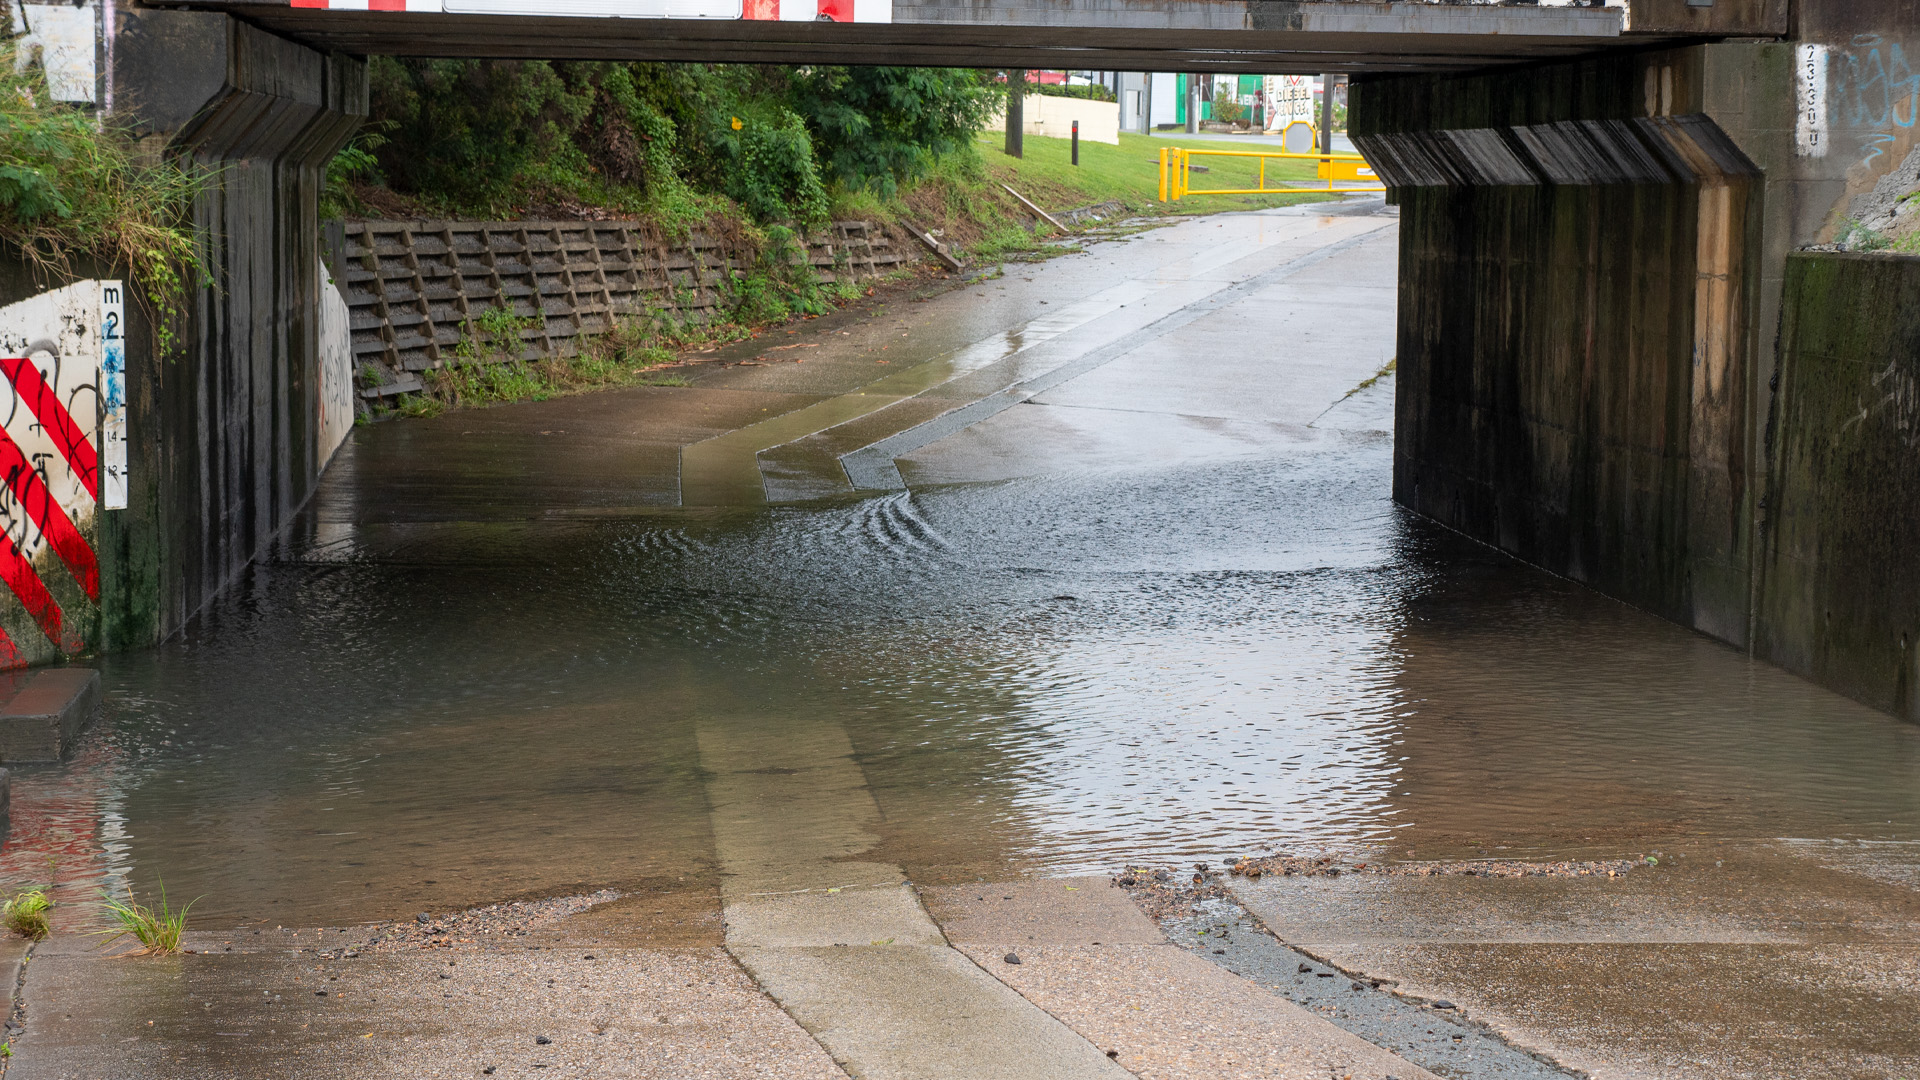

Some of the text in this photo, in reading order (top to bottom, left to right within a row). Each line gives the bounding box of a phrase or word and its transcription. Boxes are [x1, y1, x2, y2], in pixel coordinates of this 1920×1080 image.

[1276, 87, 1311, 102] DIESEL
[104, 287, 120, 304] m
[106, 311, 119, 339] 2
